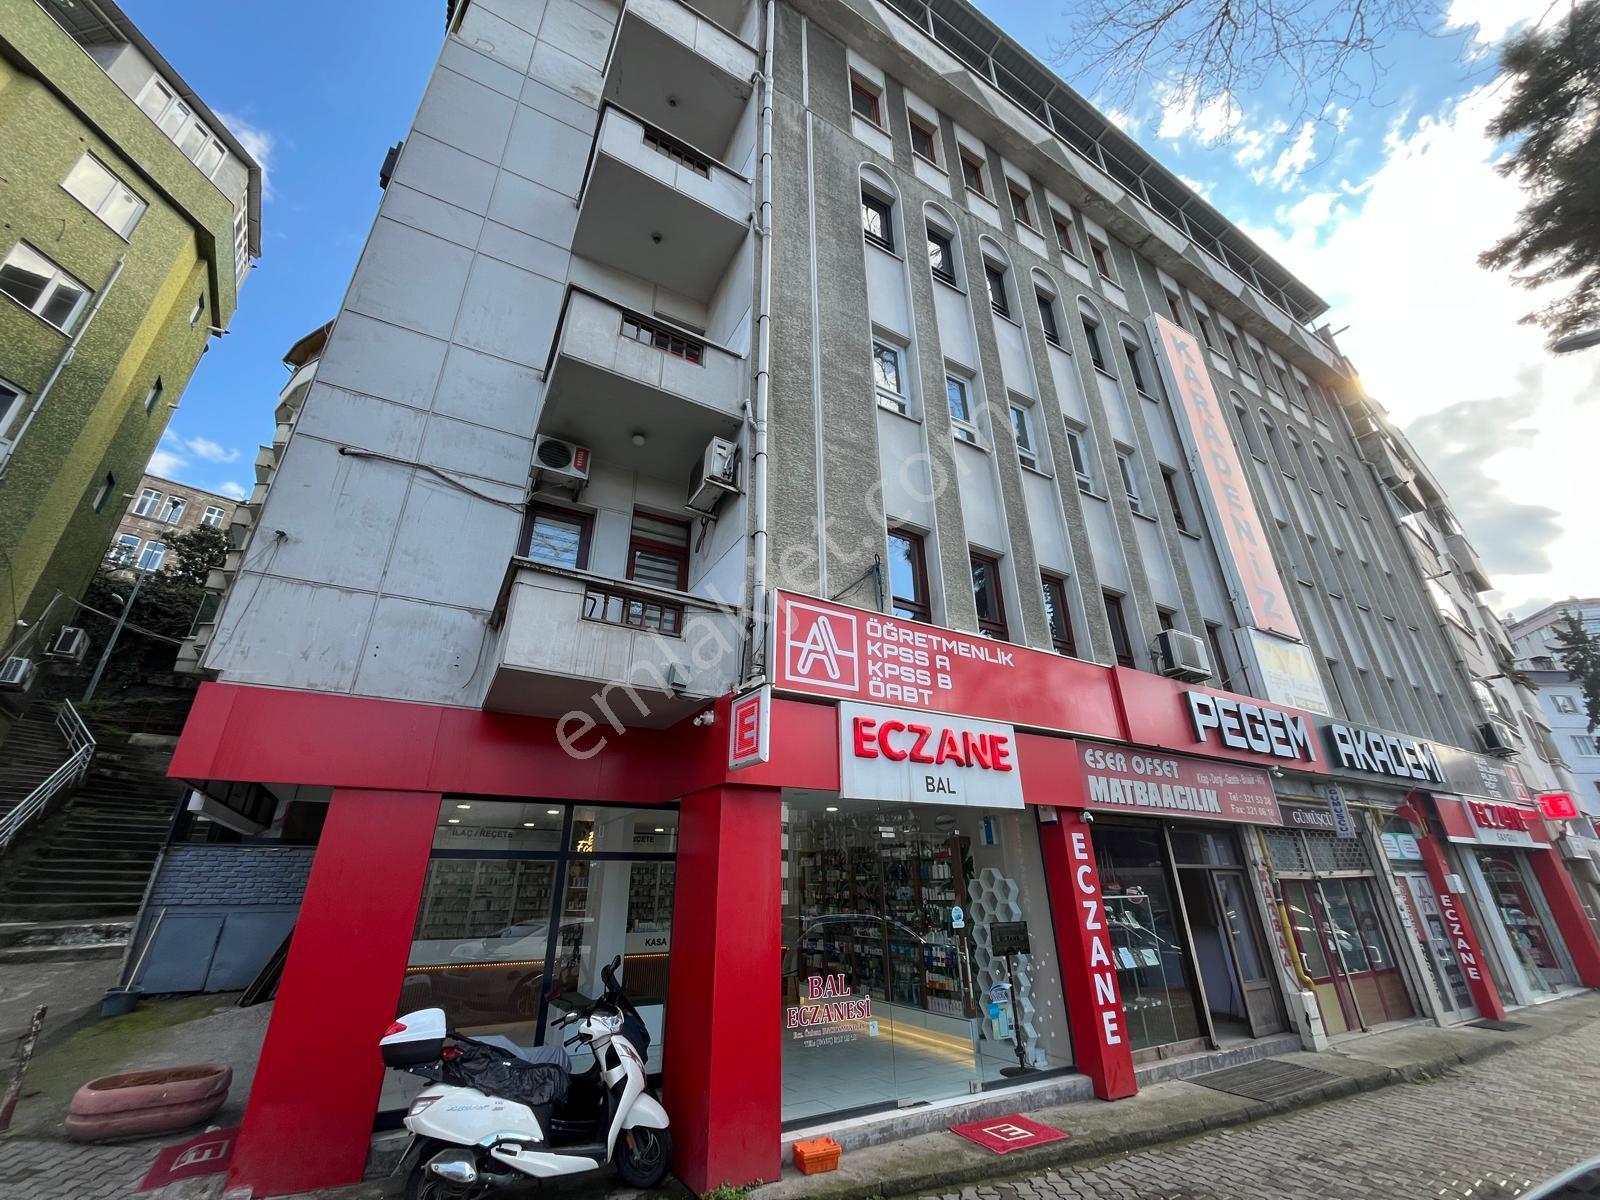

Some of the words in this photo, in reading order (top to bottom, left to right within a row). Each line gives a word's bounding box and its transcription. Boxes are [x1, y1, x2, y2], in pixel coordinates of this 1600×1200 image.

[1170, 333, 1283, 621] KARADENİZ
[866, 617, 1014, 667] ÖĞRETMENLİK
[867, 642, 930, 668] KPSS
[935, 656, 950, 672] A
[868, 659, 931, 687] KPSS
[938, 672, 953, 690] B
[868, 676, 934, 706] ÖABT
[1184, 690, 1317, 762] PEGEM
[853, 716, 1013, 772] ECZANE
[1084, 748, 1127, 773] ESER
[1131, 755, 1180, 779] OFSET
[925, 775, 957, 795] BAL
[1087, 775, 1222, 813] MATBAACILIK
[645, 938, 667, 947] KASA
[1071, 832, 1121, 1046] ECZANE
[1439, 894, 1481, 980] ECZANE
[808, 973, 850, 1000] BAL
[786, 995, 872, 1029] ECZANESİ
